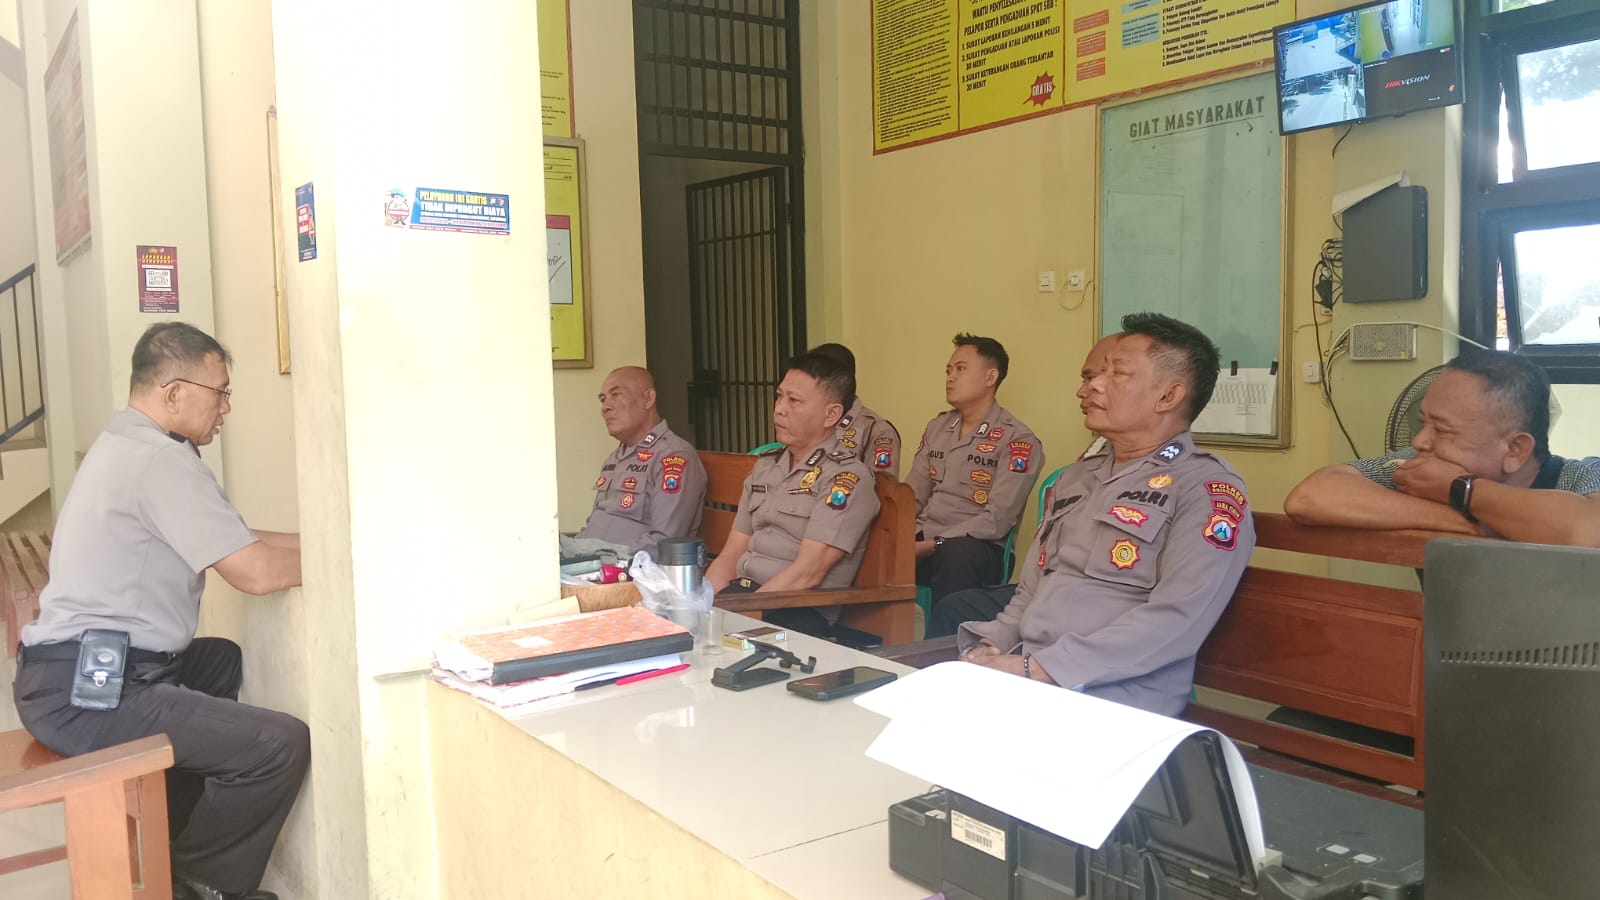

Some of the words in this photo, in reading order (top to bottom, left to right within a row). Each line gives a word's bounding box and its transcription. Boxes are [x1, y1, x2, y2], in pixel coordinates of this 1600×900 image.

[964, 22, 984, 36] PELAPOR
[985, 17, 999, 30] SERTA
[1000, 6, 1030, 24] PENGADUAN
[966, 38, 980, 50] SURAT
[980, 32, 1001, 45] LAPORAN
[966, 50, 980, 60] SURAT
[980, 42, 1008, 56] PENGADUAN
[1008, 38, 1021, 48] ATAU
[1022, 32, 1043, 44] LAPORAN
[966, 71, 980, 82] SURAT
[1384, 74, 1430, 88] HIKVISION
[1032, 82, 1052, 96] GRATIS
[1130, 118, 1159, 138] GIAT
[1165, 96, 1264, 131] MASYARAKAT
[967, 454, 998, 468] POLRI
[1117, 490, 1168, 508] POLRI
